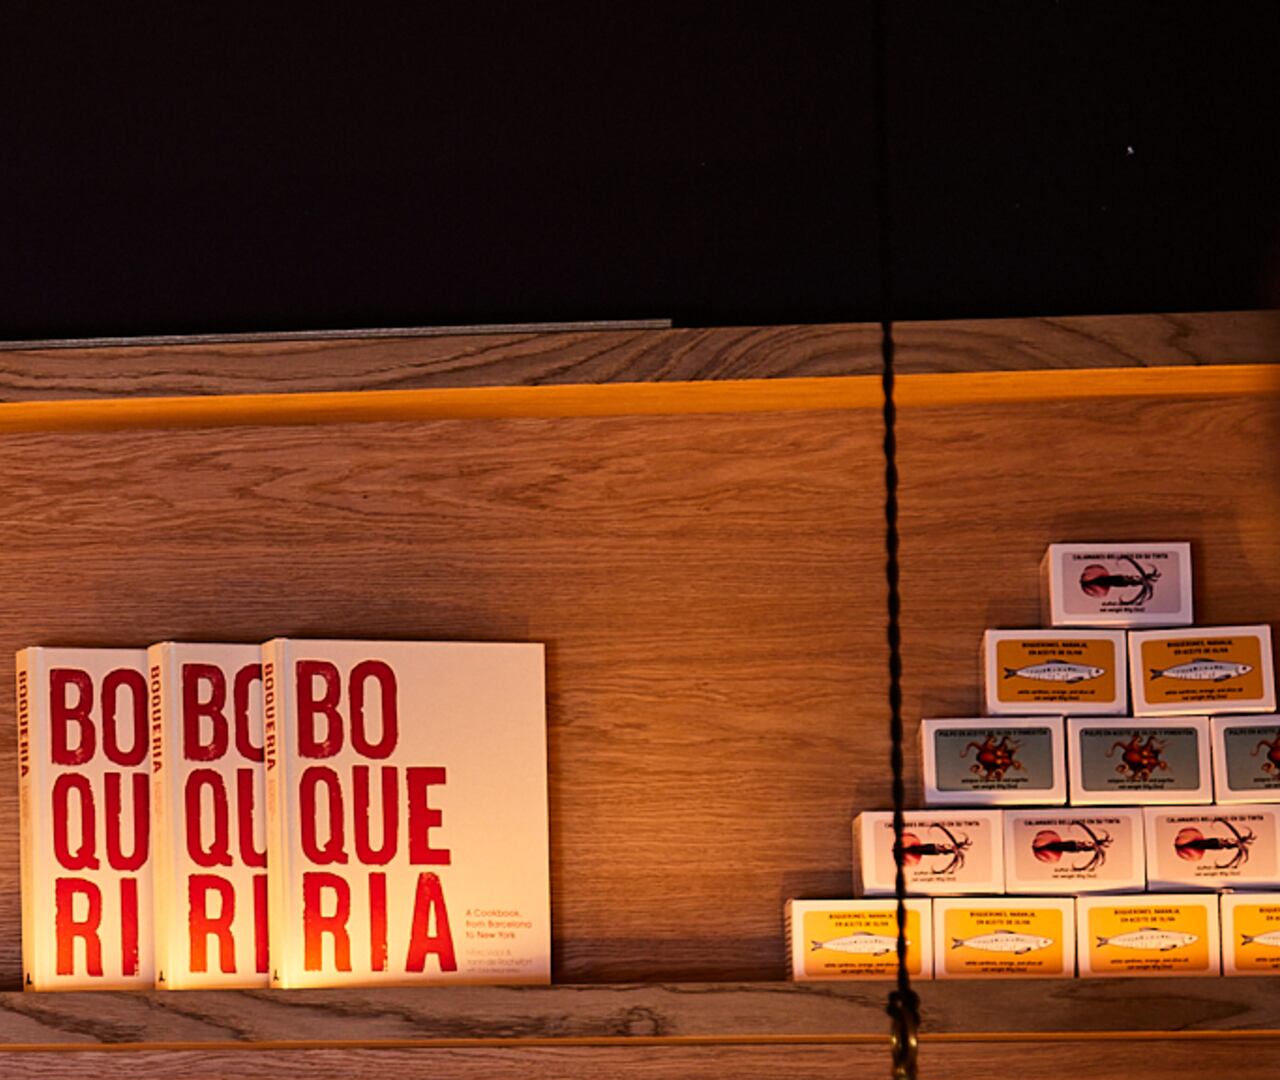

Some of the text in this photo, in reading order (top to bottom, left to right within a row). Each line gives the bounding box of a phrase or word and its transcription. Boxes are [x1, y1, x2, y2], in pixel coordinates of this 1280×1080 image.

[296, 659, 398, 760] BO
[299, 765, 451, 866] QUE
[302, 872, 458, 974] RIA
